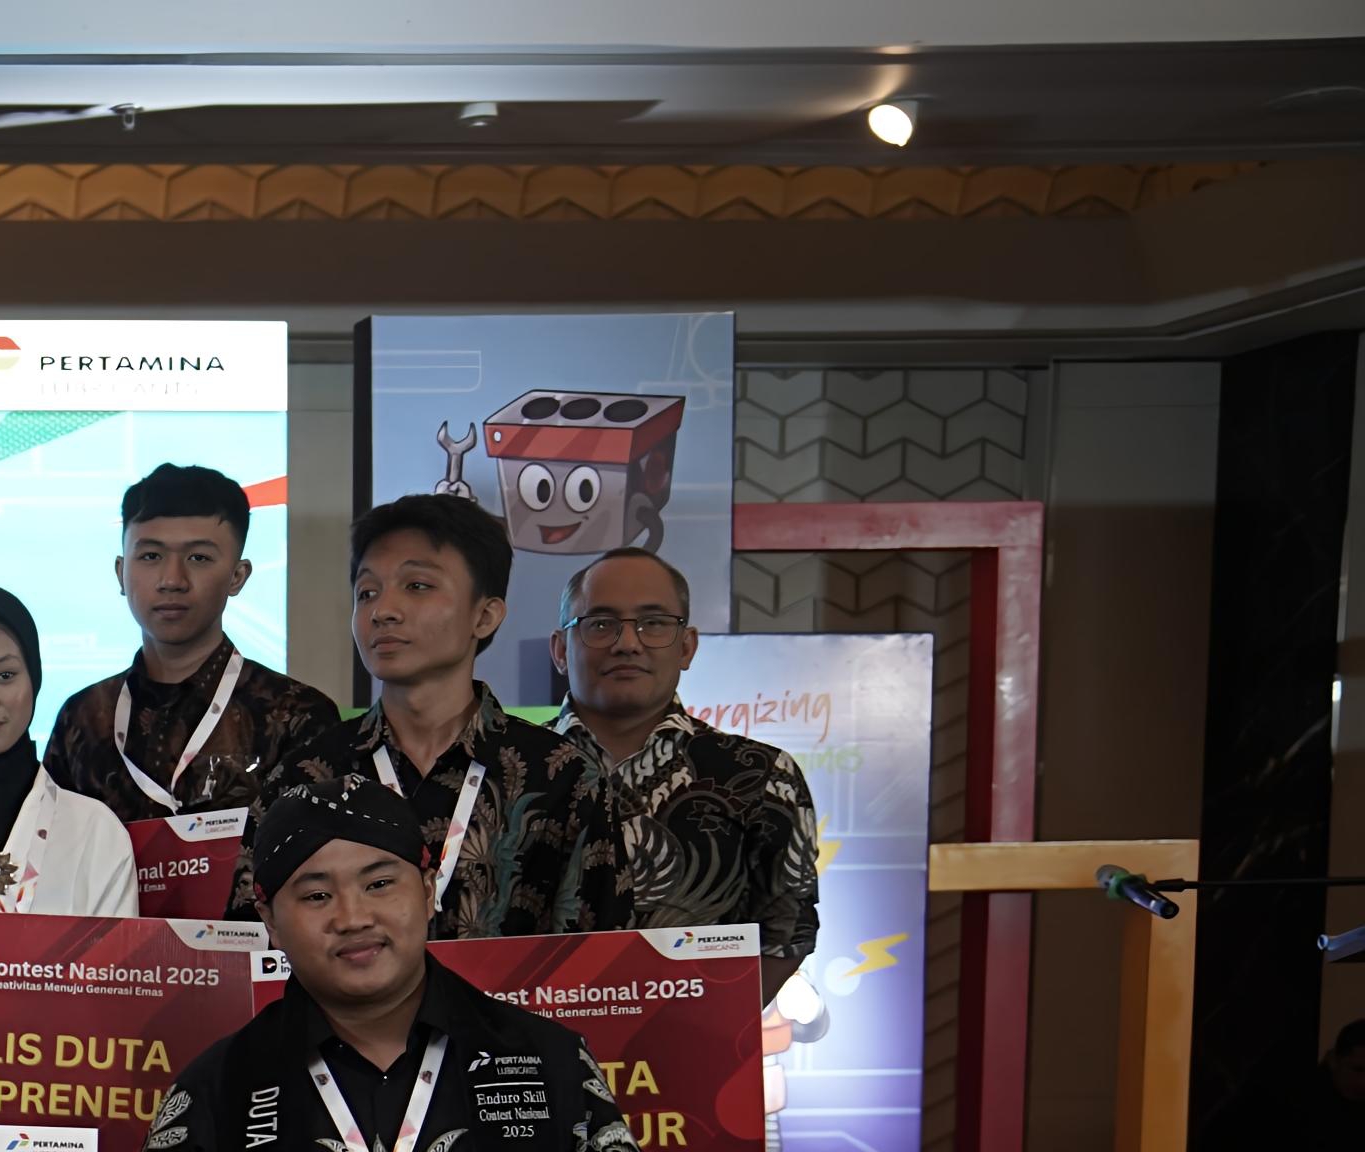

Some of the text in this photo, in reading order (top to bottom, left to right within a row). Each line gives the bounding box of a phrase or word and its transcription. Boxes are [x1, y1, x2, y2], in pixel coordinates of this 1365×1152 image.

[41, 357, 224, 370] PERTAMINA
[168, 857, 209, 876] 2025
[70, 963, 161, 983] Nasional
[167, 967, 218, 985] 2025
[536, 979, 703, 1004] Nasional 2025
[556, 1006, 642, 1017] Generasi Emas
[56, 1035, 170, 1072] DUTA
[477, 1091, 546, 1105] Enduro Skill
[246, 1087, 279, 1148] DUTA
[479, 1107, 549, 1121] Contest Nasional
[503, 1126, 534, 1137] 2025
